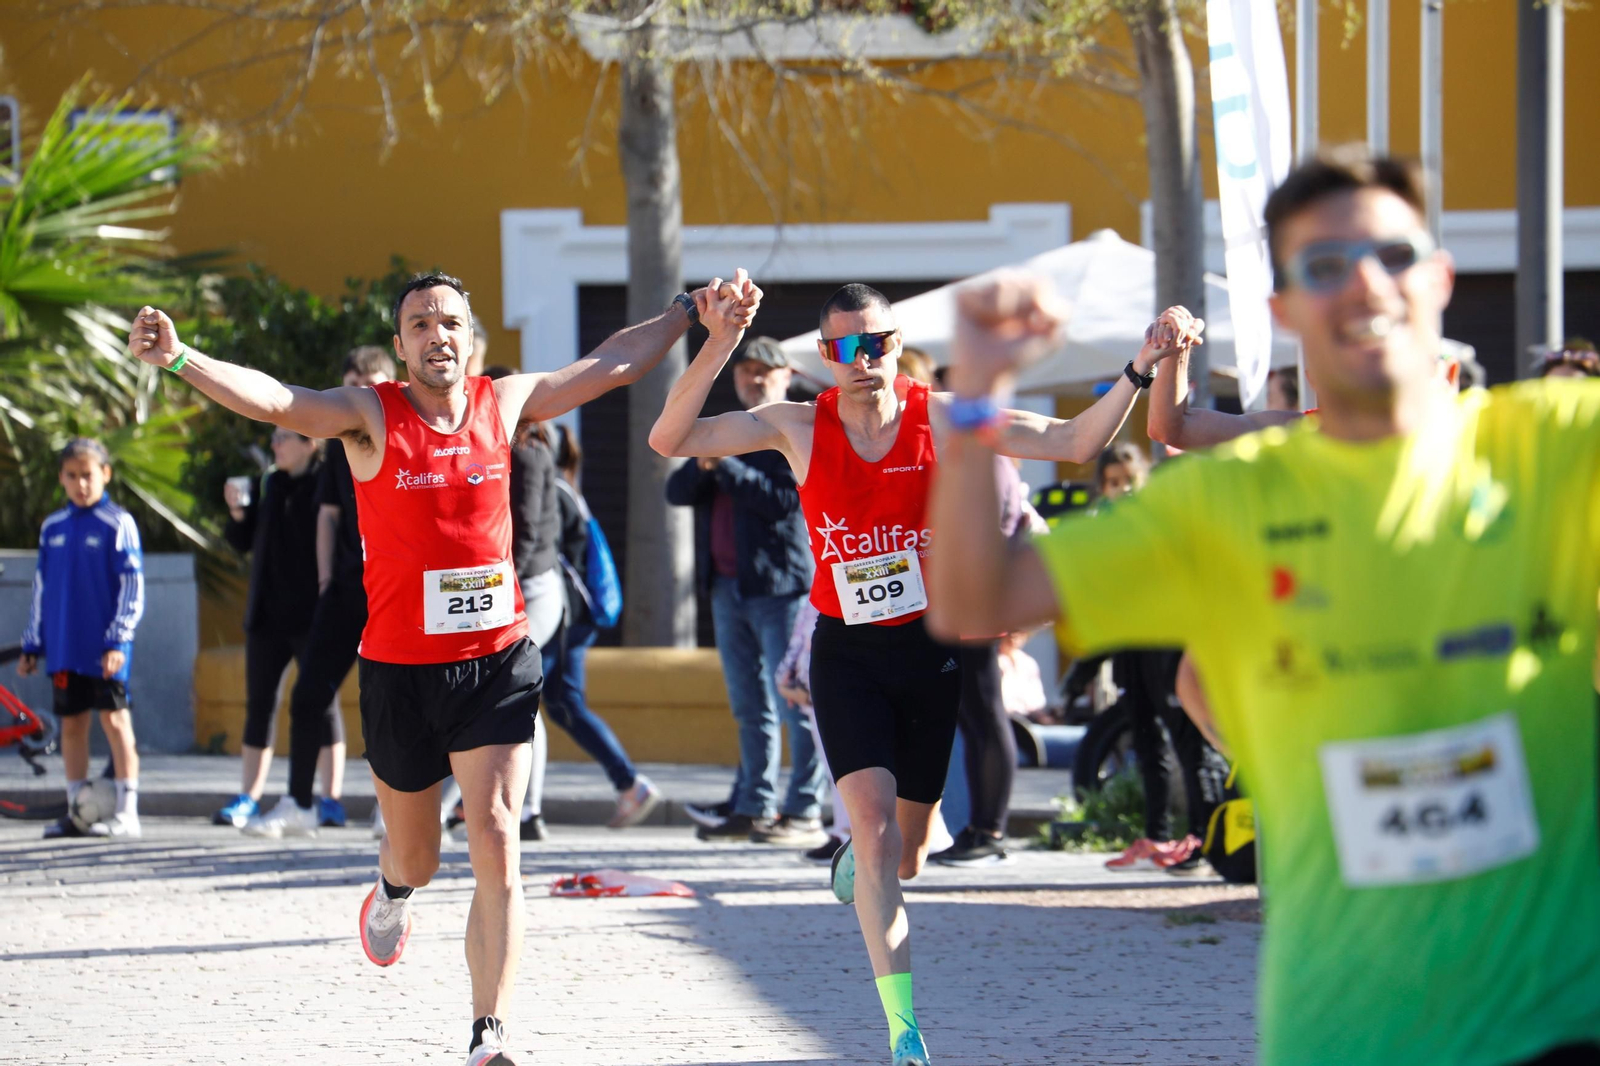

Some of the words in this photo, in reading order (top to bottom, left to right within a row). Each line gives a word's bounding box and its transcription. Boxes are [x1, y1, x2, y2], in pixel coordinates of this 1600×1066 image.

[406, 472, 445, 486] califas
[842, 524, 932, 555] califas
[447, 593, 494, 615] 213
[855, 580, 905, 605] 109
